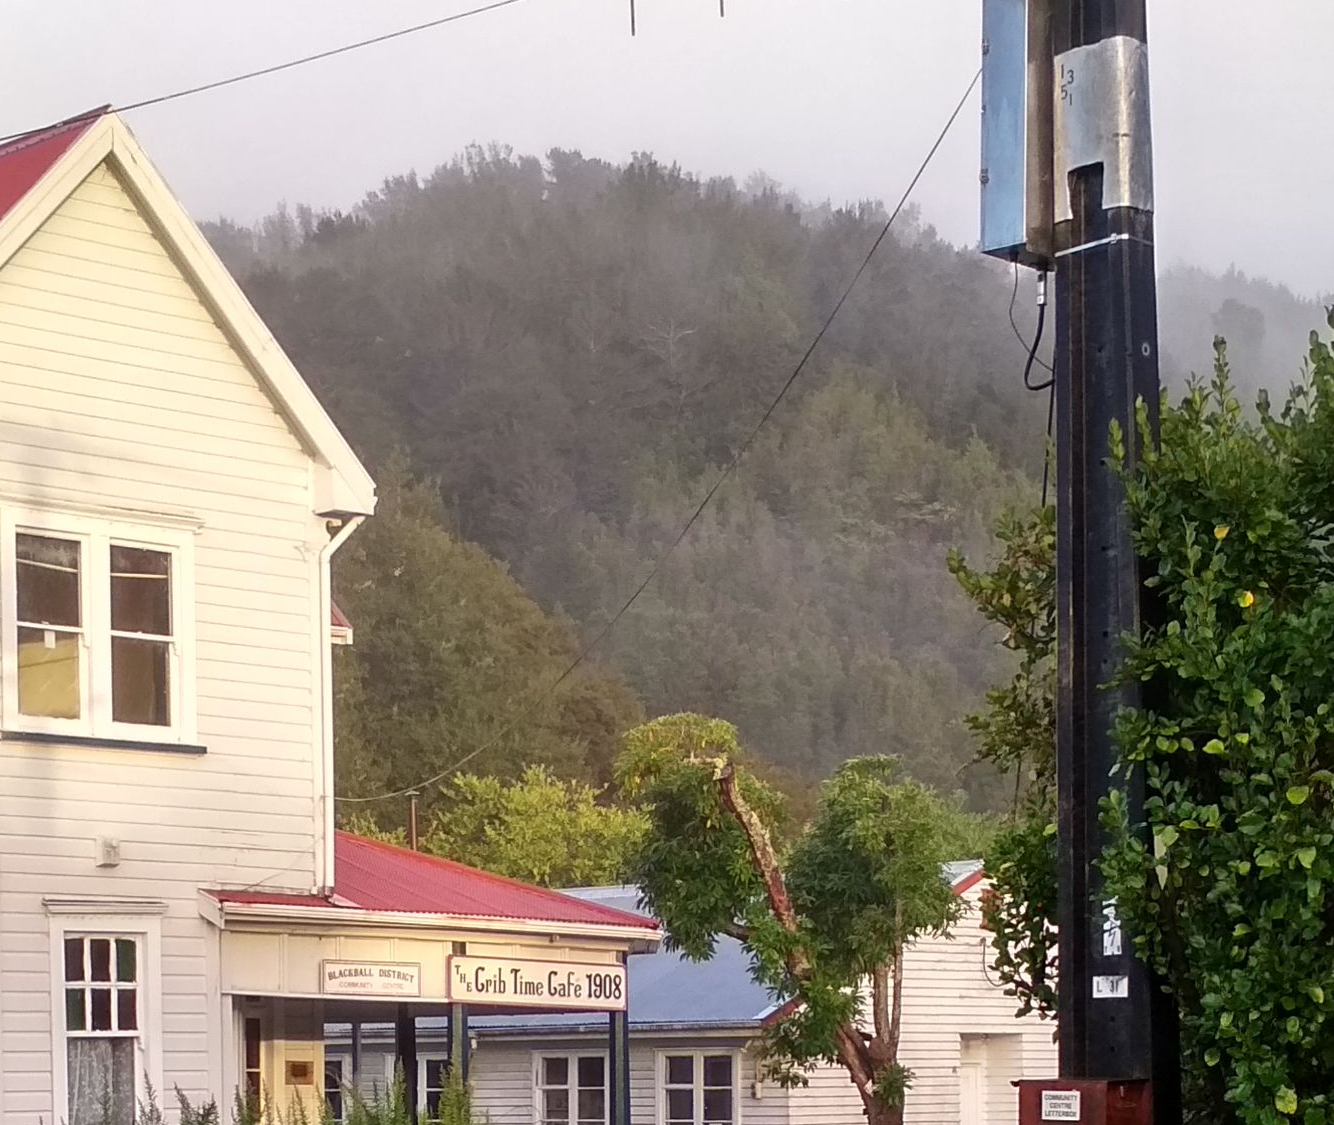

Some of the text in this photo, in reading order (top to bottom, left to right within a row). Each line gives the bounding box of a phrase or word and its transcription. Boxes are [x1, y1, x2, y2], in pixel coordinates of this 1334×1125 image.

[328, 968, 414, 983] BLACKBALL DISTRICT
[511, 968, 544, 997] Time
[586, 973, 622, 1000] 1908
